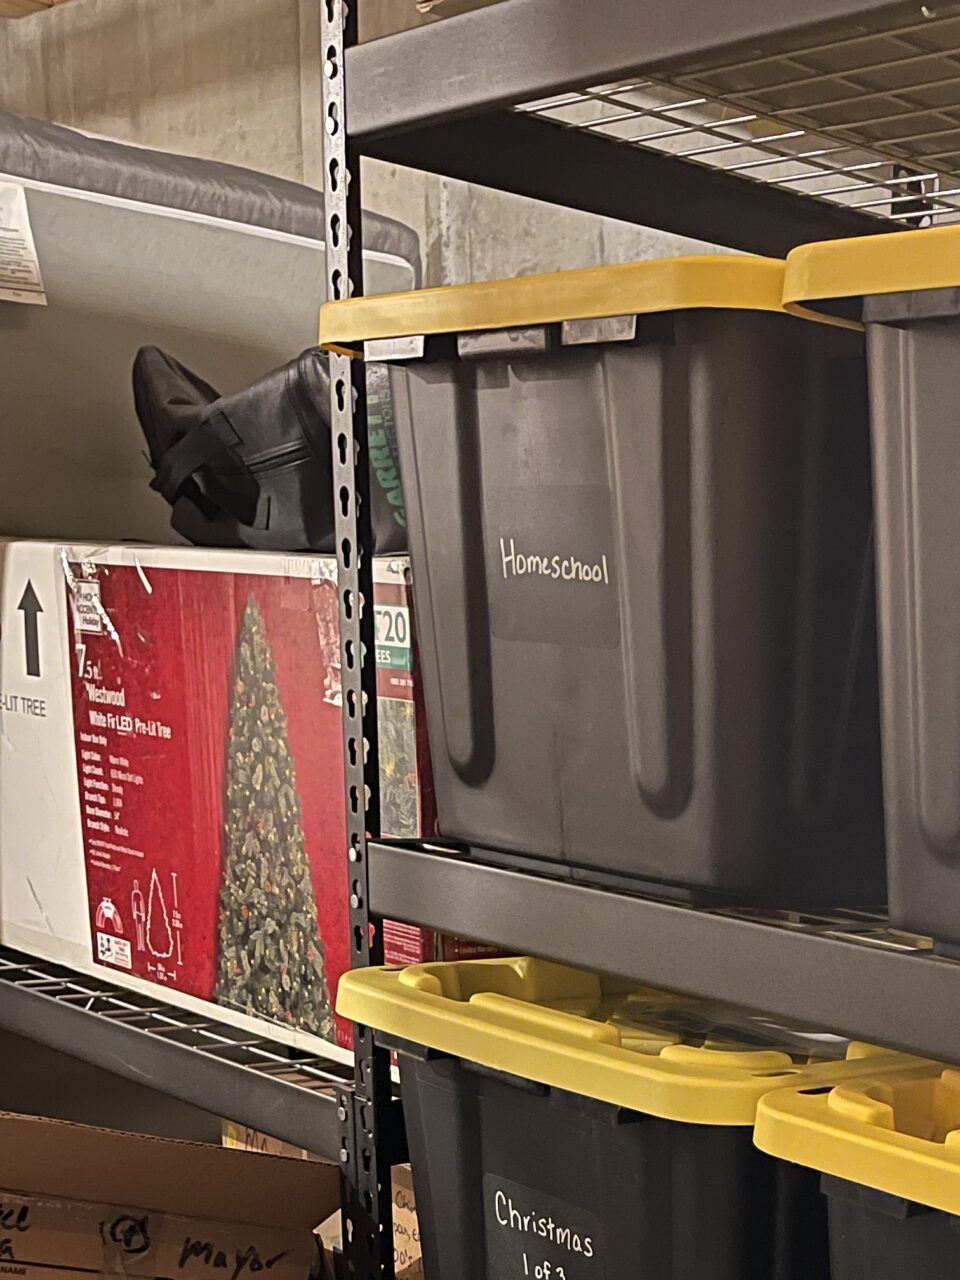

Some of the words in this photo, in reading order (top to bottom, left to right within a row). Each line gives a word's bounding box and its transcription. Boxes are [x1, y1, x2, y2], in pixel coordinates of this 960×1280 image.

[500, 537, 608, 584] Homeschool
[22, 697, 47, 718] TREE
[85, 681, 126, 707] Westwood
[89, 710, 107, 728] White
[107, 713, 116, 729] Fir
[116, 715, 133, 732] LED
[135, 718, 157, 737] Pre-Lit
[157, 721, 172, 739] Tree
[494, 1190, 594, 1257] Christmas
[1, 1266, 28, 1277] NAME
[522, 1252, 529, 1276] 1
[534, 1260, 551, 1280] of
